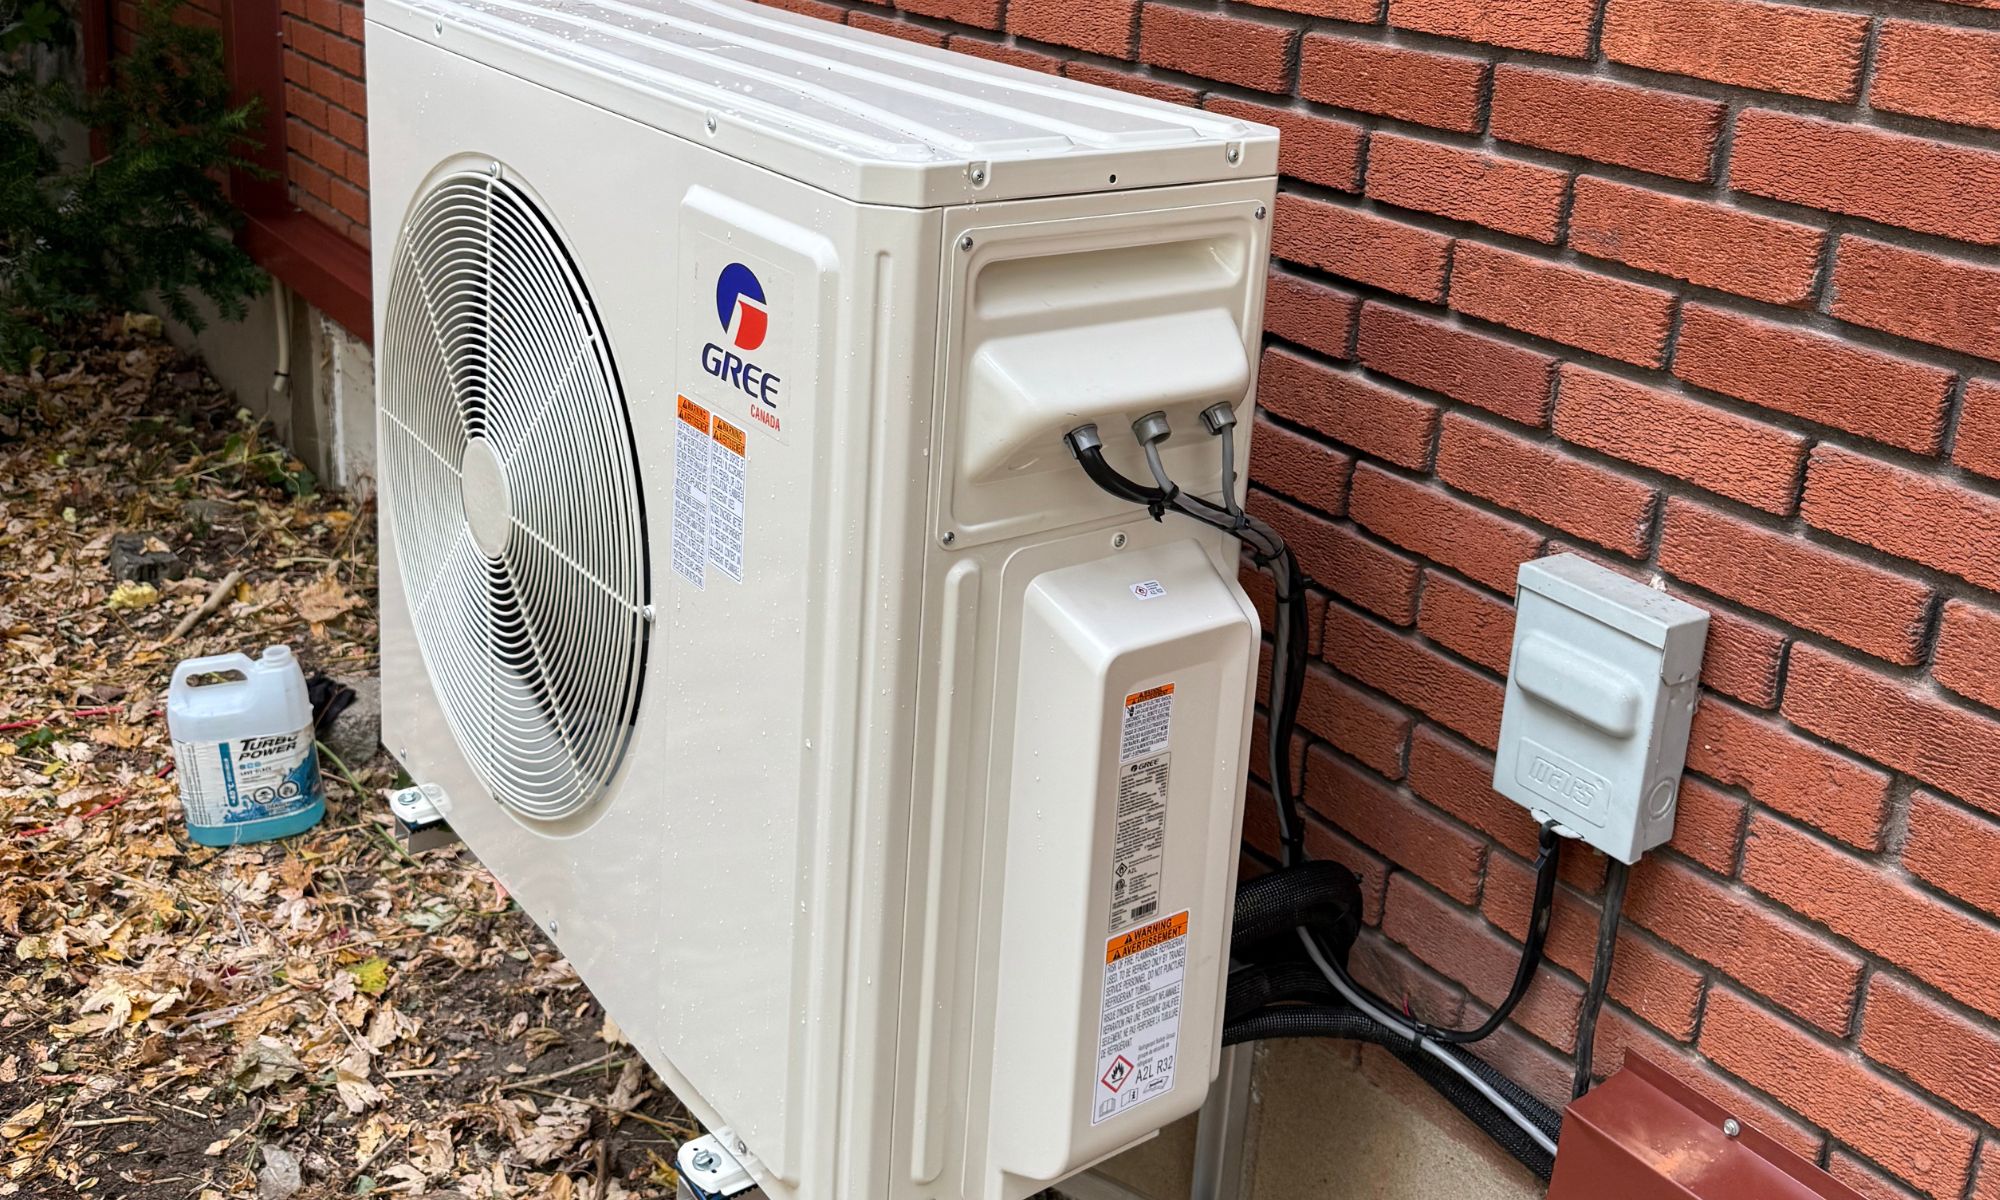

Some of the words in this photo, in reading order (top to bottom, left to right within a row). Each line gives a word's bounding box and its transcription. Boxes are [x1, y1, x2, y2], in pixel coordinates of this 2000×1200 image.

[702, 342, 780, 409] GREE
[750, 404, 781, 432] CANADA
[239, 742, 296, 761] POWER
[1139, 758, 1160, 770] GREE
[1134, 918, 1172, 940] WARNING
[1122, 926, 1181, 957] AVERTISSEMENT
[1136, 1064, 1153, 1084] A2L
[1157, 1055, 1173, 1075] R32
